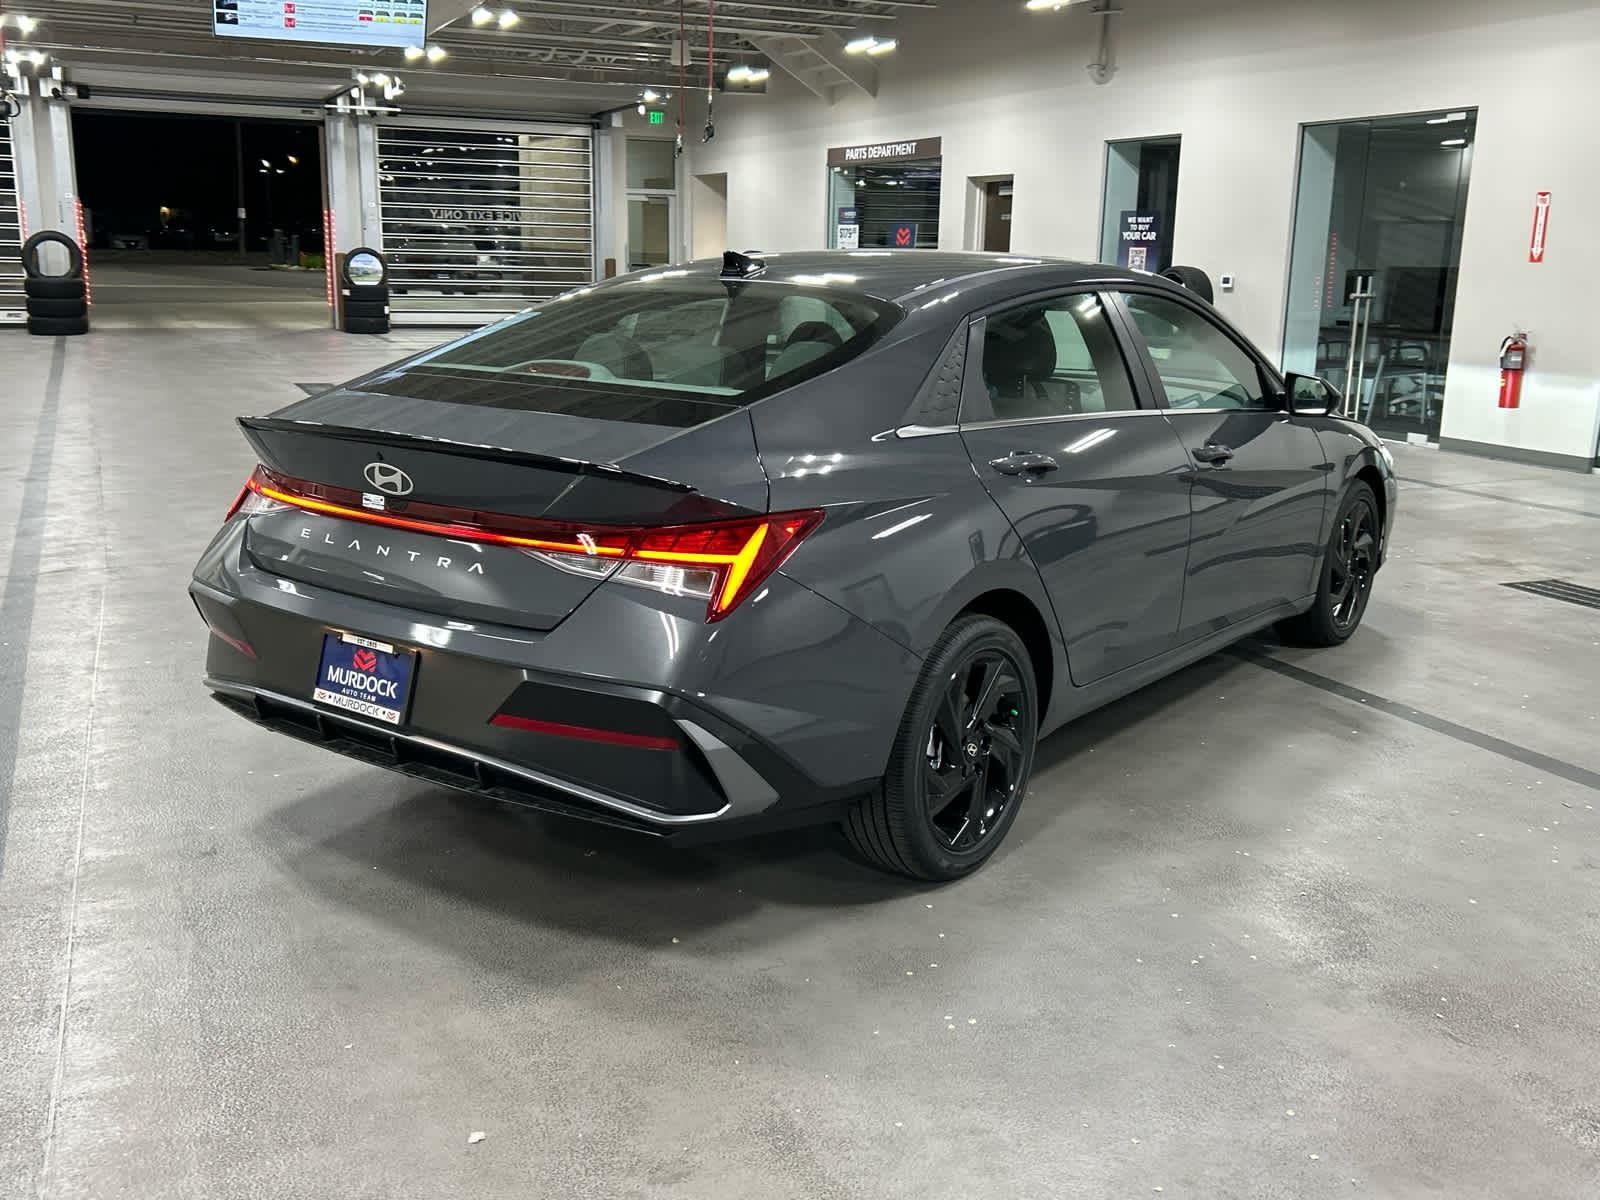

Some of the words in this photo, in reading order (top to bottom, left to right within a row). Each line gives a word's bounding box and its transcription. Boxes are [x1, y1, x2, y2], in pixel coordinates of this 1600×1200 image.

[845, 147, 867, 160] PARTS
[867, 142, 917, 159] DEPARTMENT
[1122, 231, 1141, 240] YOUR
[1141, 231, 1156, 240] CAR
[300, 527, 484, 575] ELANTRA
[327, 664, 398, 700] MURDOCK
[341, 687, 358, 697] AUTO
[359, 692, 377, 703] TEAM
[332, 695, 380, 716] MURDOCK
